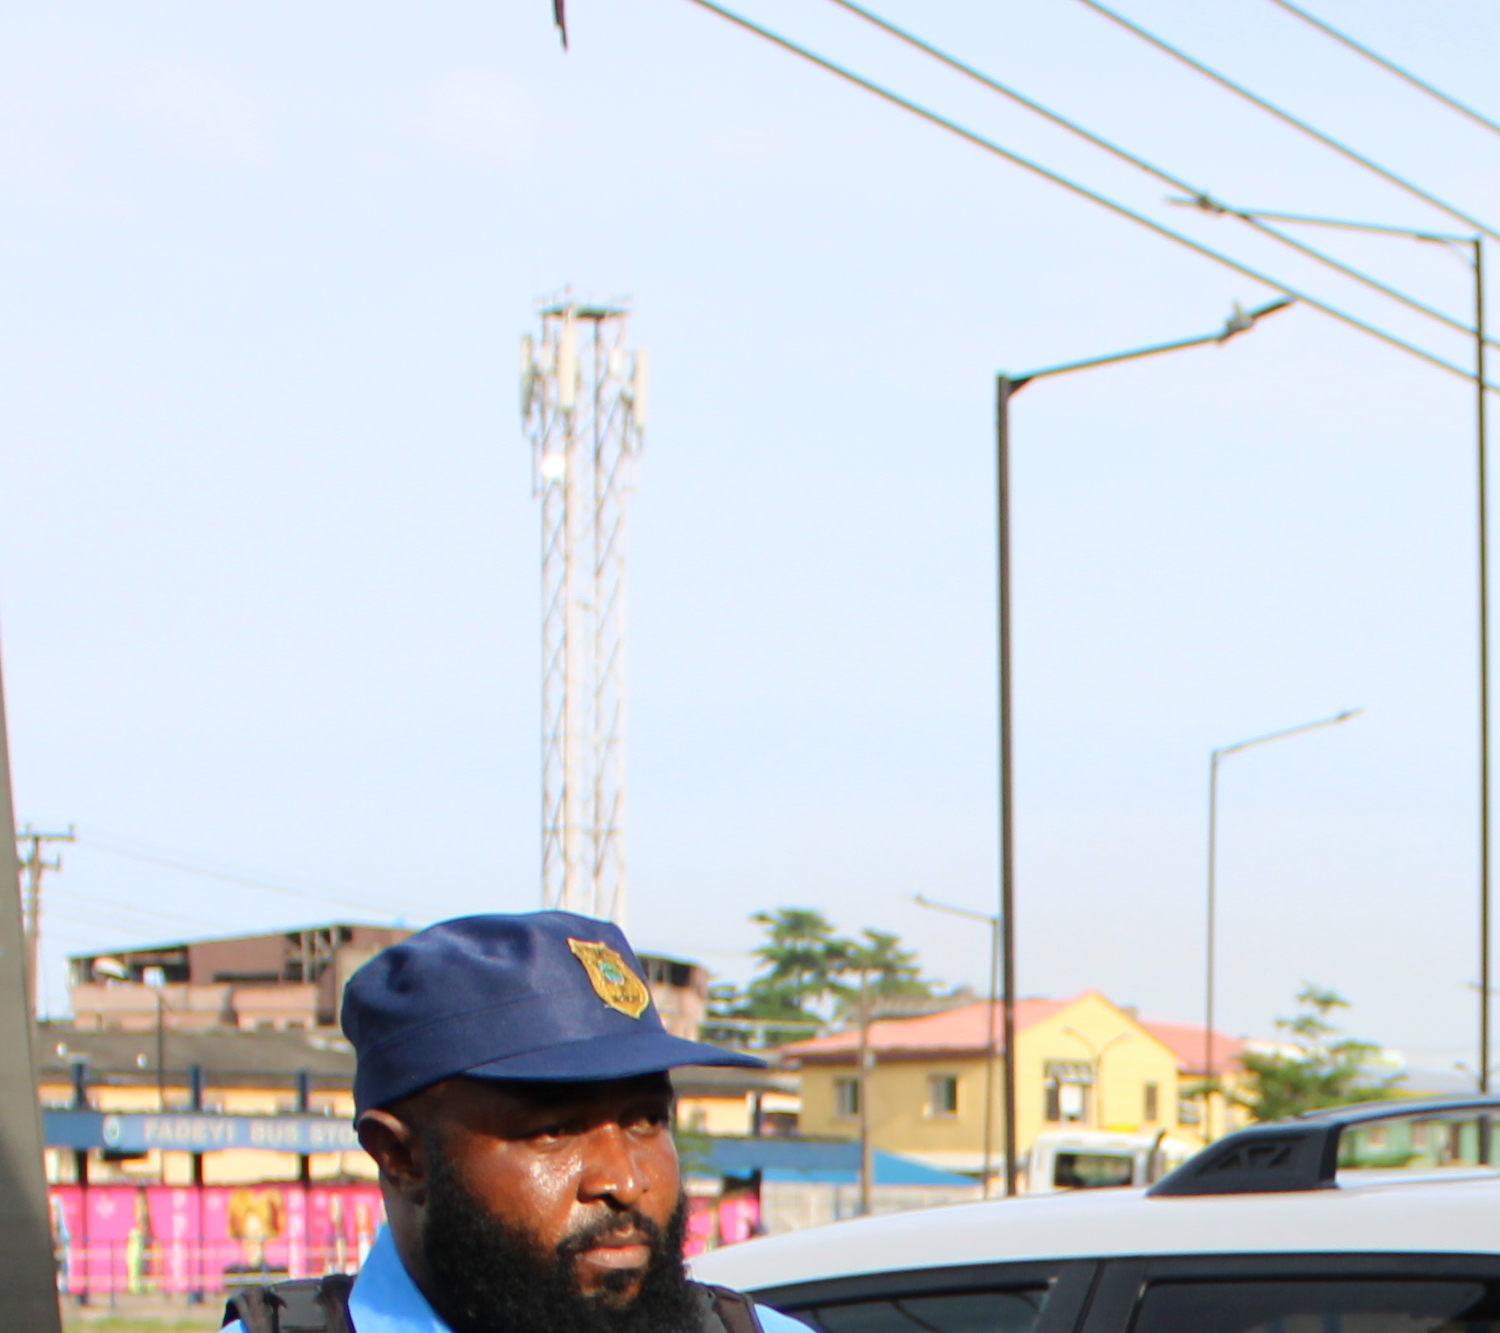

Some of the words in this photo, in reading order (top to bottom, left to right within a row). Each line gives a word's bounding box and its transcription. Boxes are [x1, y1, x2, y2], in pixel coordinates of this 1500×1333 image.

[145, 1118, 235, 1143] FADEYI
[250, 1119, 298, 1144] BUS
[310, 1120, 357, 1146] STO
